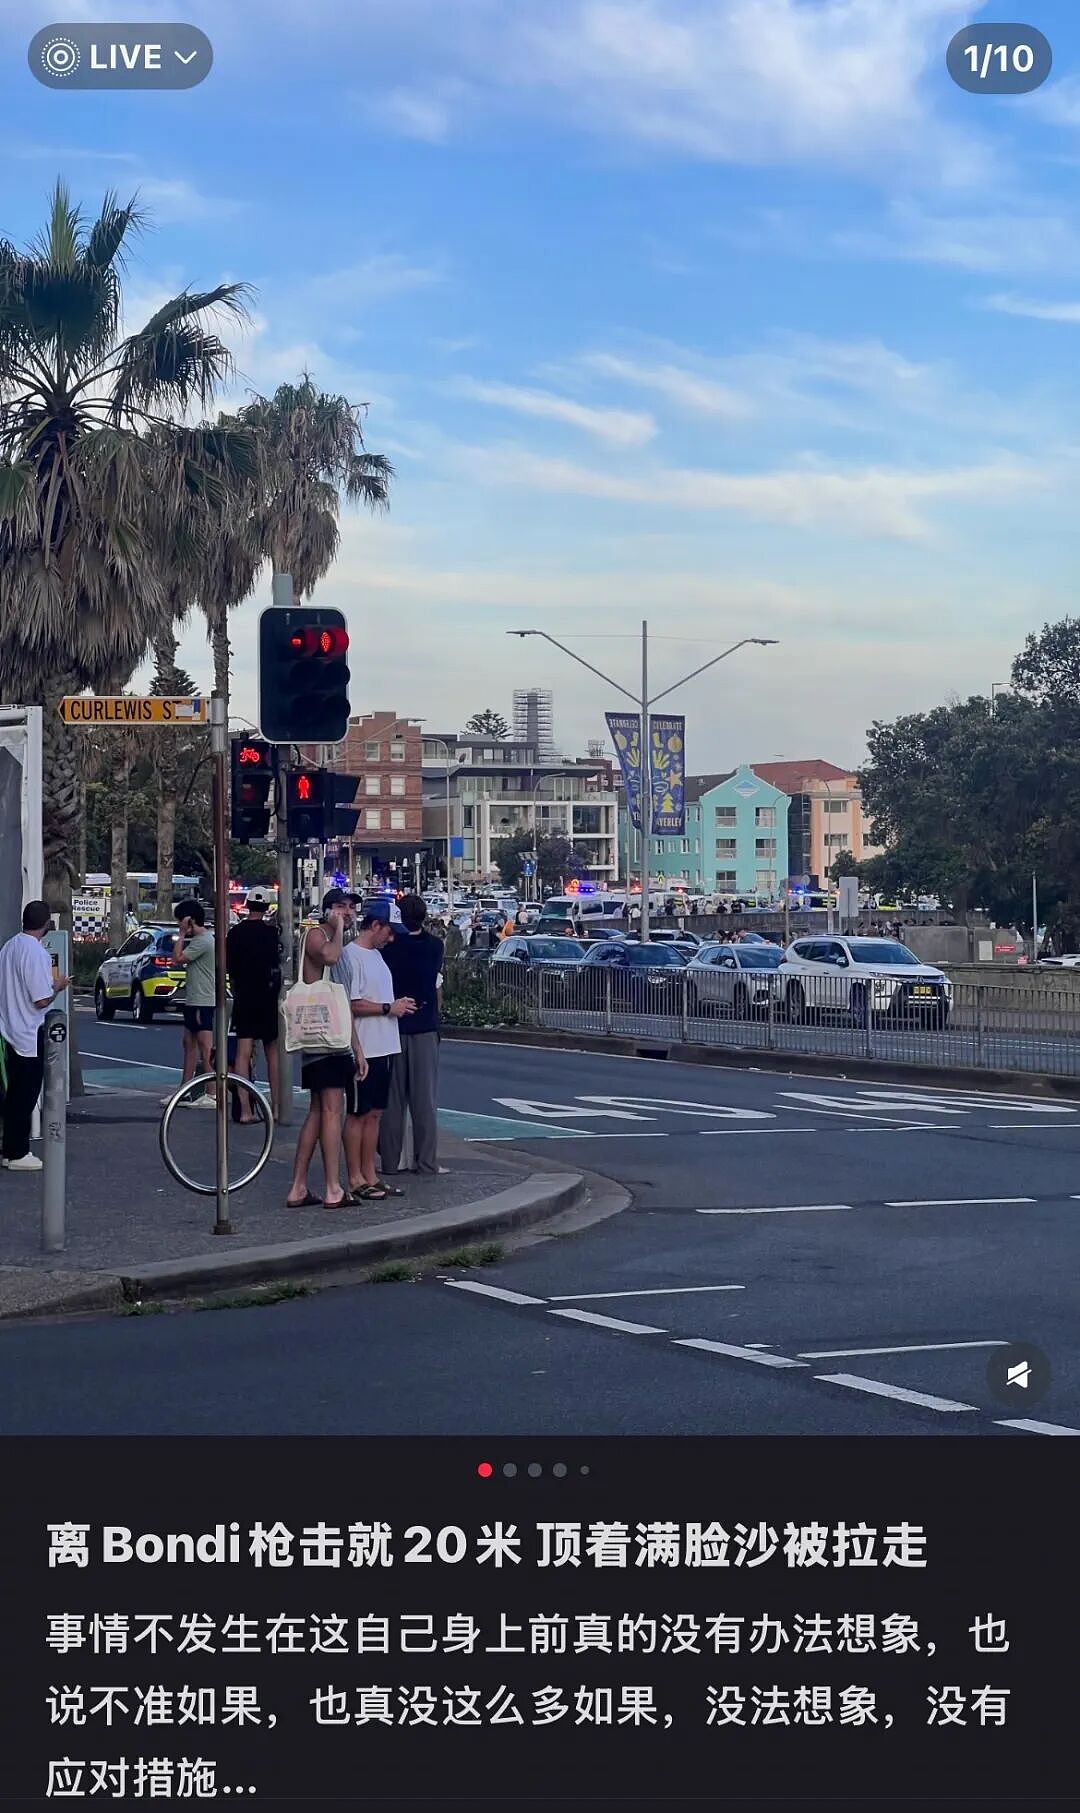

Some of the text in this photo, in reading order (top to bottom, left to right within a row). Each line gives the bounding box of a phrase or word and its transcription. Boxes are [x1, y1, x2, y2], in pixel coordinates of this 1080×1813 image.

[70, 700, 152, 720] CURLEWIS
[491, 1096, 778, 1121] 40
[776, 1091, 1078, 1113] 40
